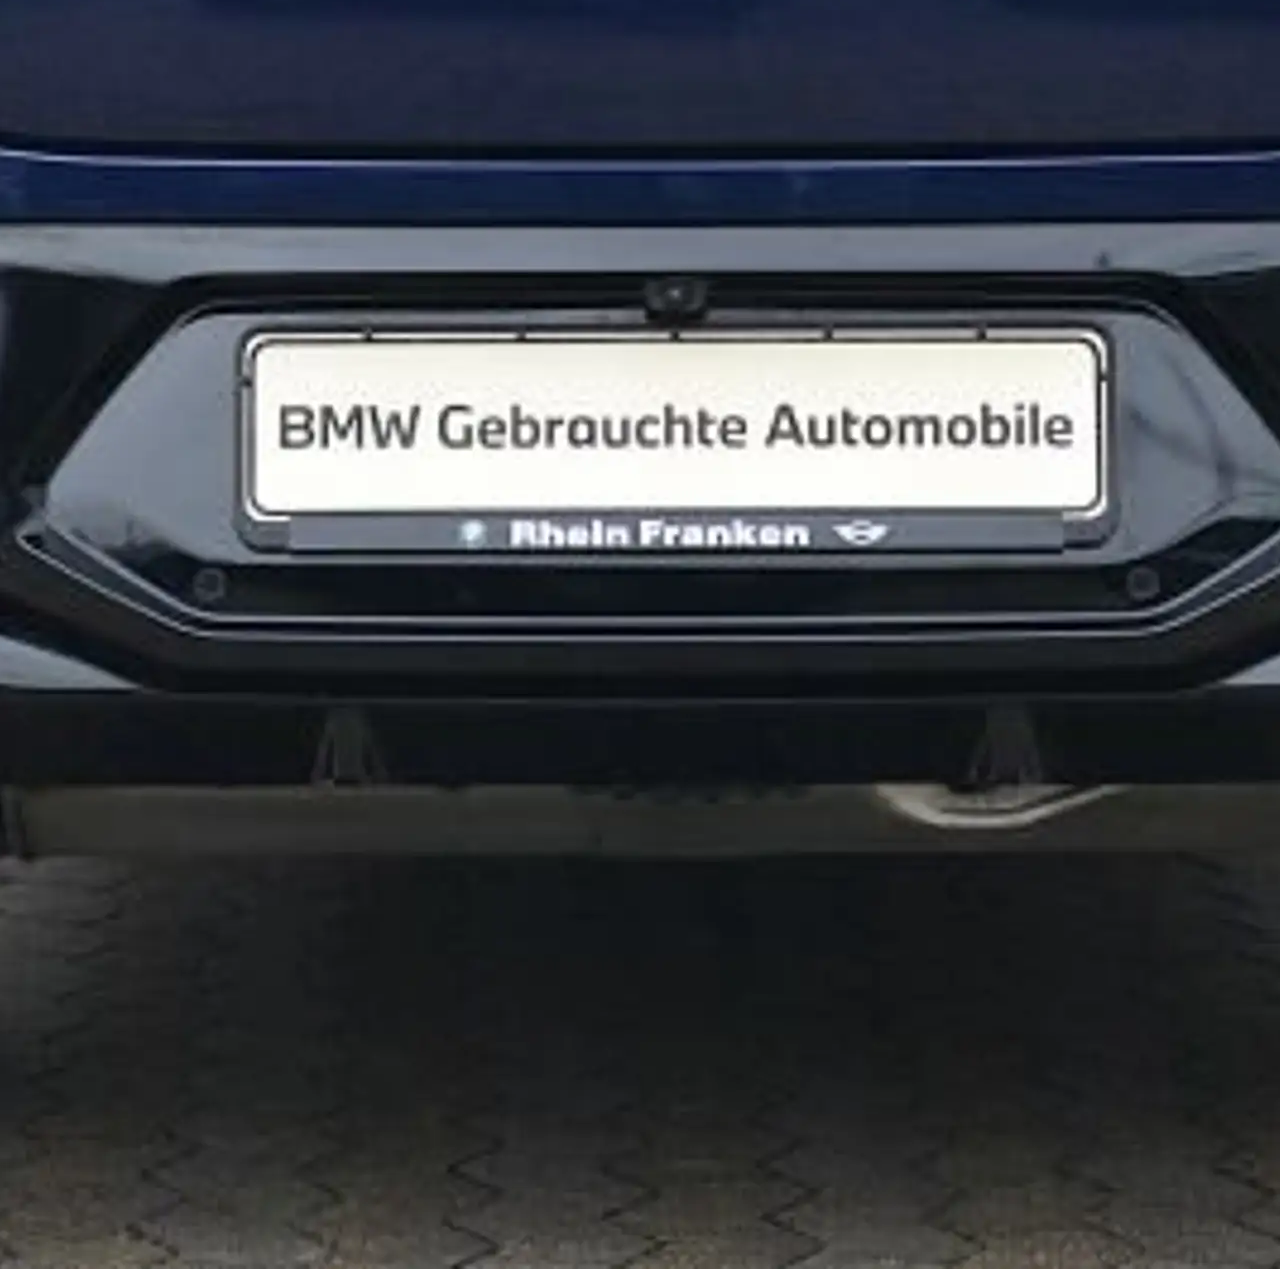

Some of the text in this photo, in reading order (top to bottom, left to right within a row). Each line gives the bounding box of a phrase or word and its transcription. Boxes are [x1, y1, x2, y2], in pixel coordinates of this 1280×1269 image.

[280, 404, 1072, 449] BMW Gebrauchte Automobile
[511, 520, 809, 546] Rhein Franken
